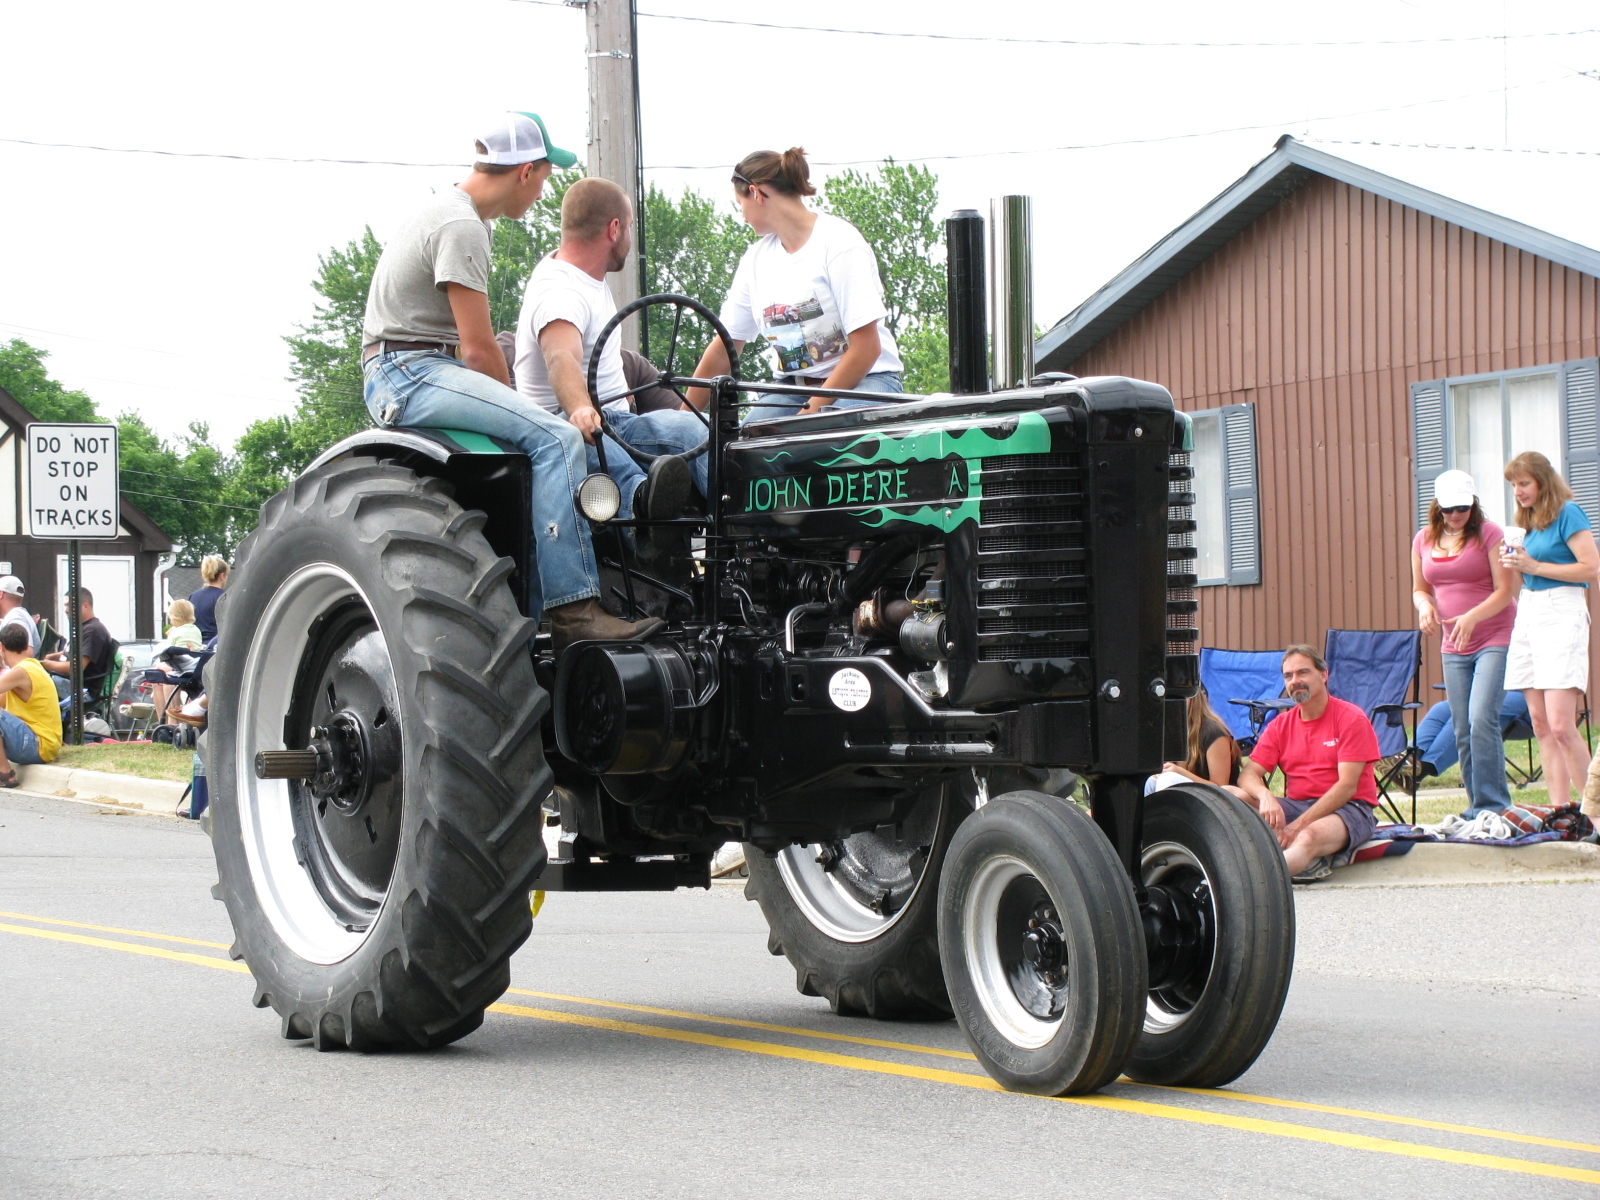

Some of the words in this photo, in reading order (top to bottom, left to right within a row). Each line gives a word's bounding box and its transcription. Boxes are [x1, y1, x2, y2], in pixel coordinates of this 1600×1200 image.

[36, 436, 61, 453] DO
[74, 437, 110, 454] NOT
[48, 461, 99, 478] STOP
[59, 485, 88, 502] ON
[744, 475, 812, 512] JOHN
[827, 468, 909, 506] DEERE
[948, 465, 964, 495] A
[35, 508, 113, 526] TRACKS
[958, 994, 1027, 1072] ARMSTRONG
